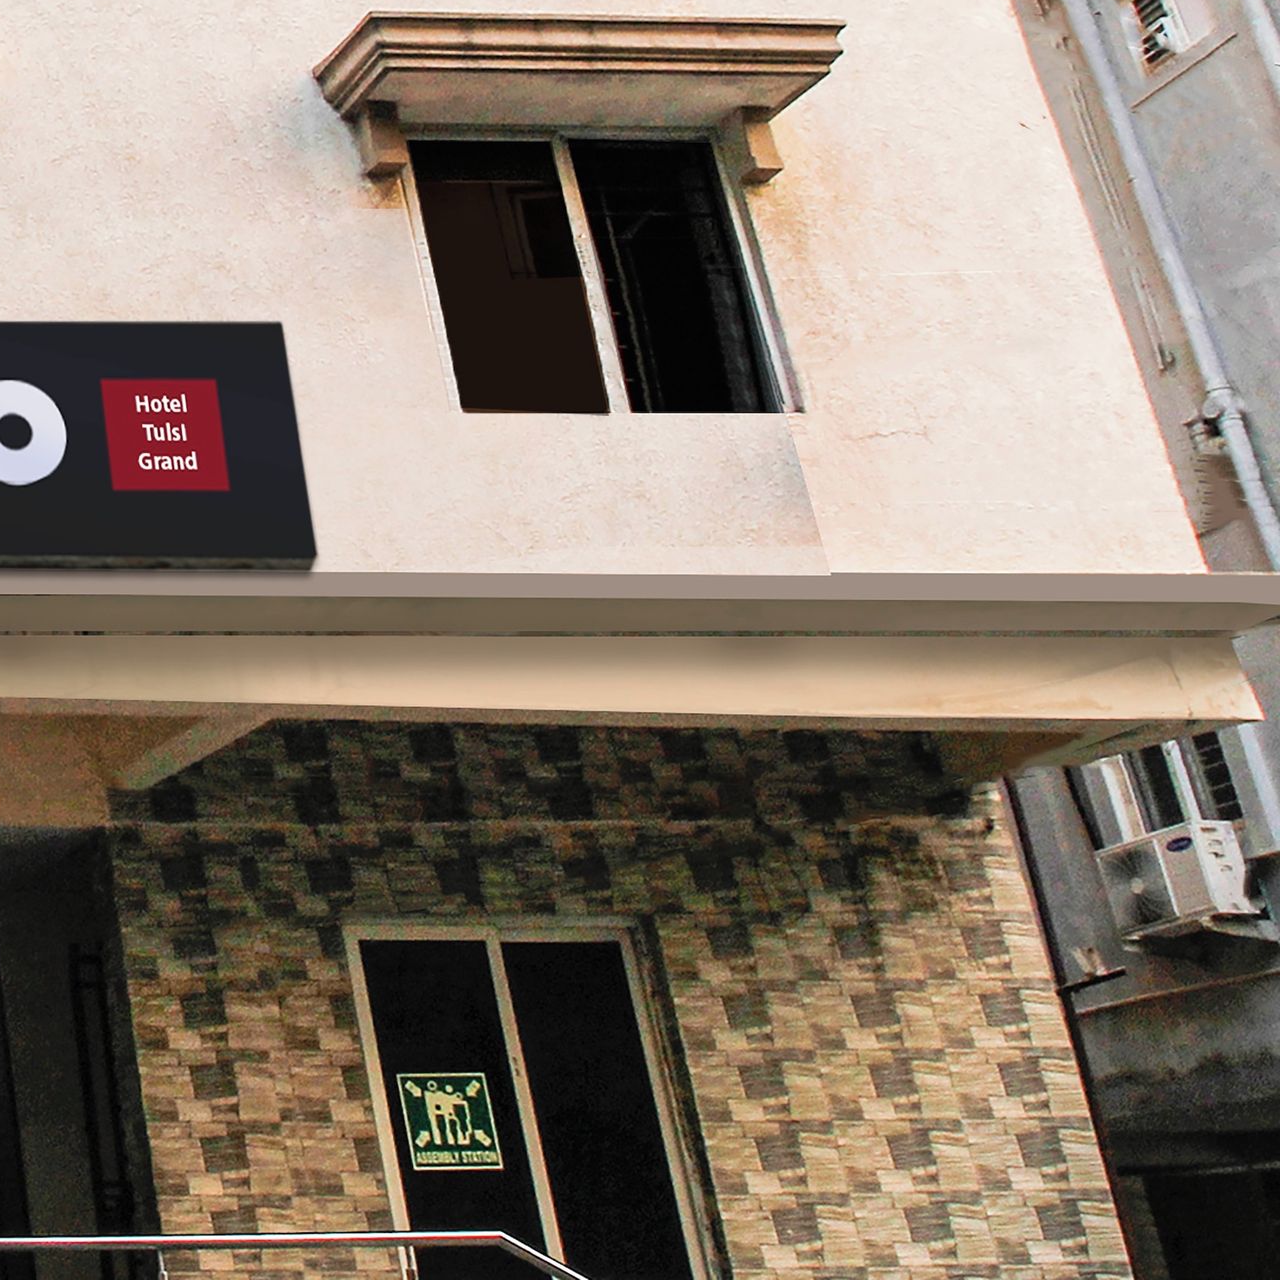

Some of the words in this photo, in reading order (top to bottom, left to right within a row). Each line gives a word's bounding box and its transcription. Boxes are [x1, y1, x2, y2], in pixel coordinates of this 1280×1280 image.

[134, 393, 188, 413] Hotel
[138, 451, 198, 471] Grand
[461, 1151, 498, 1163] STATION
